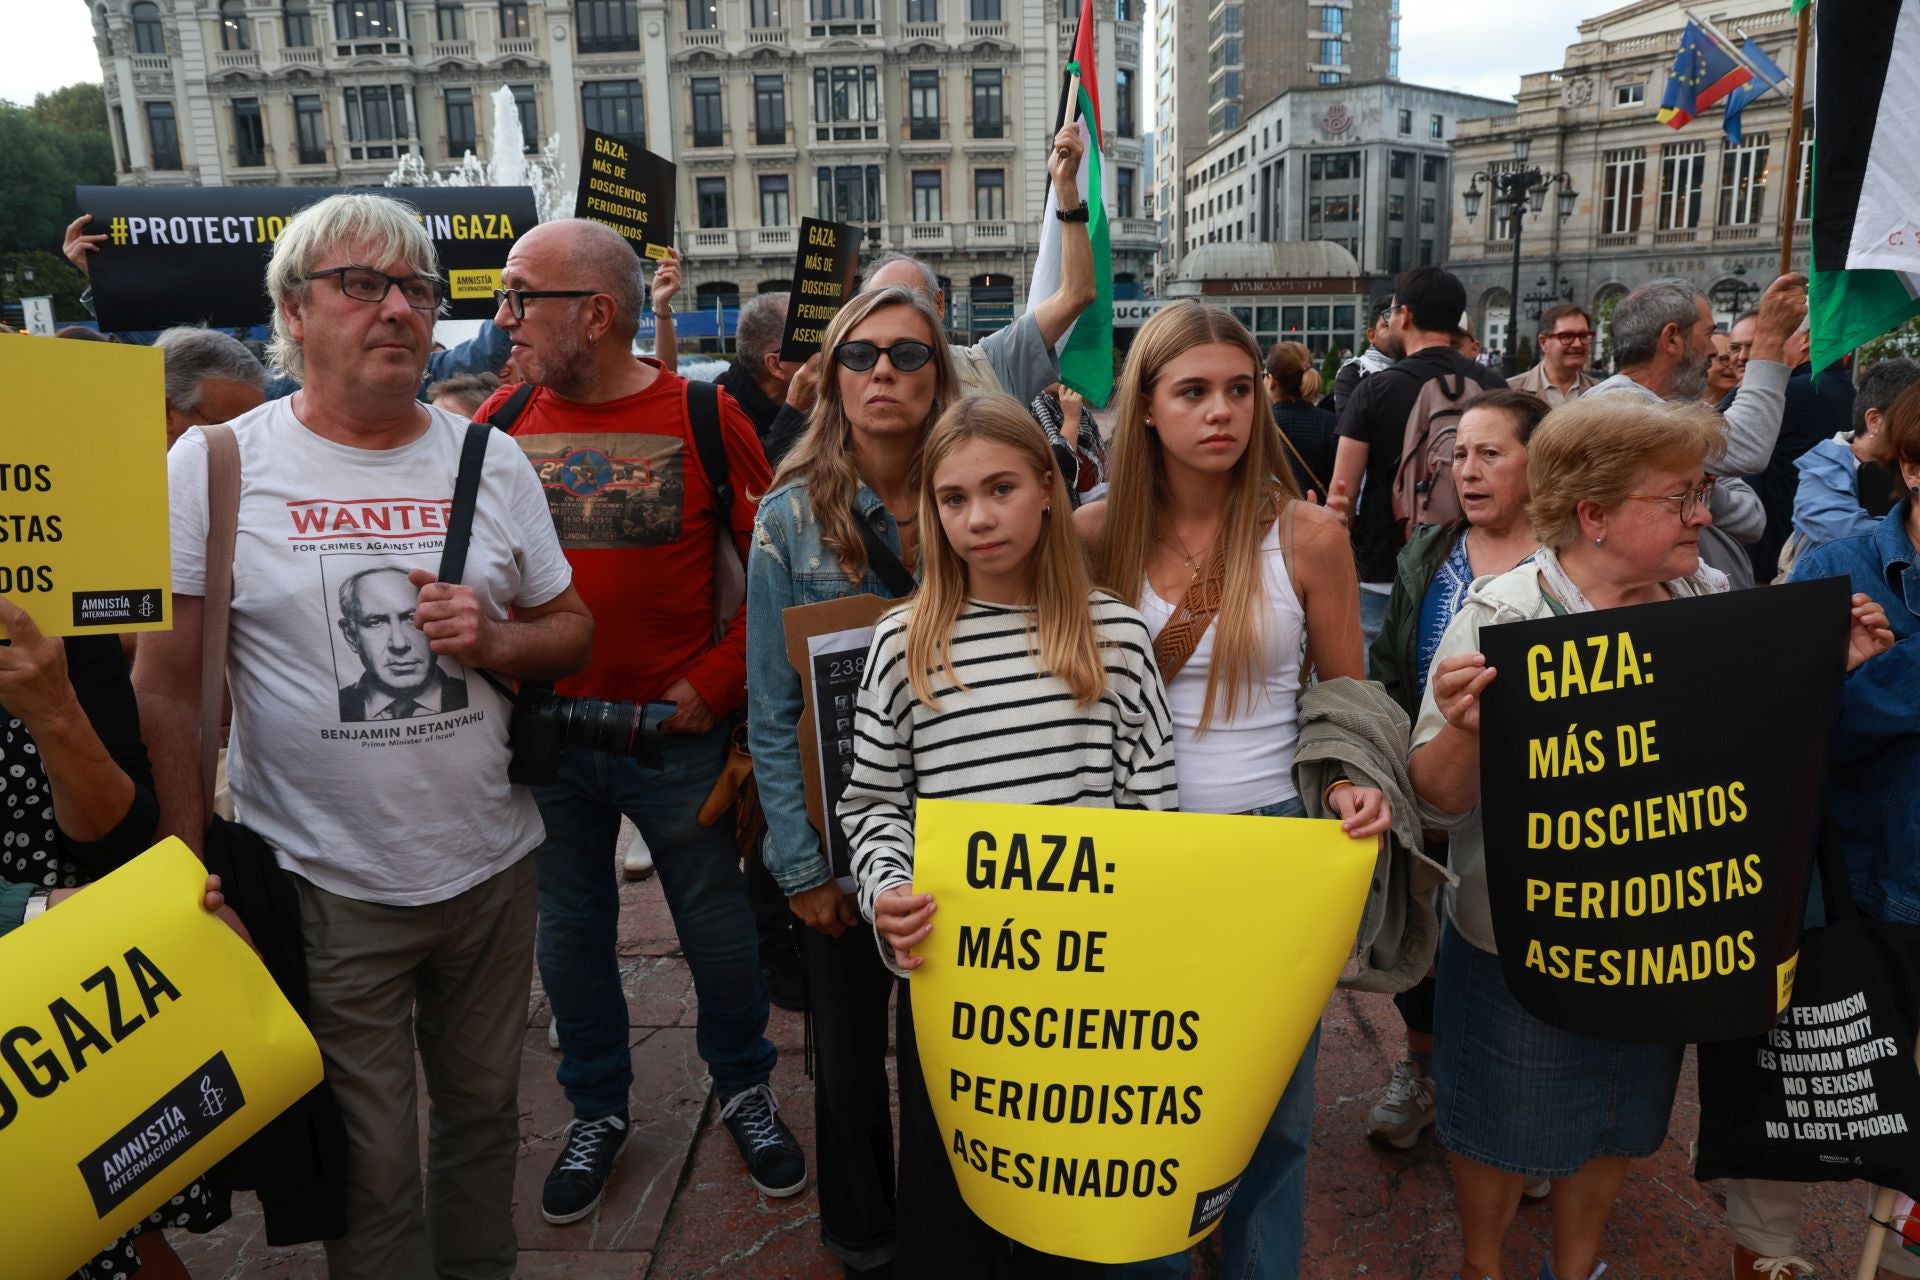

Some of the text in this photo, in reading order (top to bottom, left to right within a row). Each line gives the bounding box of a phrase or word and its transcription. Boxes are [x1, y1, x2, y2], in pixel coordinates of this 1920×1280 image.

[594, 137, 628, 161] GAZA:
[592, 158, 626, 179] MÁS DE
[590, 177, 647, 204] DOSCIENTOS
[587, 196, 648, 223] PERIODISTAS
[808, 225, 836, 248] GAZA:
[804, 252, 833, 272] MÁS DE
[1648, 259, 1706, 274] TEATRO
[456, 274, 493, 285] AMNISTÍA
[293, 544, 317, 553] FOR
[320, 542, 363, 551] CRIMES
[366, 541, 415, 551] AGAINST
[82, 596, 130, 611] AMNISTÍA
[82, 609, 130, 619] INTERNACIONAL
[1527, 631, 1655, 702] GAZA:
[320, 710, 485, 740] BENJAMIN NETANYAHU
[389, 736, 423, 746] Minister
[425, 734, 434, 743] of
[435, 730, 456, 741] Israel
[1529, 720, 1660, 779] MÁS DE
[1527, 780, 1748, 851] DOSCIENTOS
[965, 829, 1116, 894] GAZA:
[1525, 853, 1763, 919] PERIODISTAS
[956, 918, 1108, 973] MÁS DE
[1524, 930, 1756, 986] ASESINADOS
[1792, 991, 1868, 1027] FEMINISM
[951, 1001, 1200, 1051] DOSCIENTOS
[1767, 1015, 1872, 1049] YES HUMANITY
[1780, 1050, 1844, 1073] HUMAN
[1846, 1036, 1898, 1067] RIGHTS
[1783, 1068, 1874, 1095] NO SEXISM
[949, 1068, 1204, 1126] PERIODISTAS
[1785, 1092, 1879, 1118] NO RACISM
[1765, 1113, 1908, 1141] NO LGBTI-PHOBIA
[101, 1105, 187, 1182] AMNISTÍA
[108, 1125, 191, 1195] INTERNACIONAL
[952, 1128, 1180, 1198] ASESINADOS
